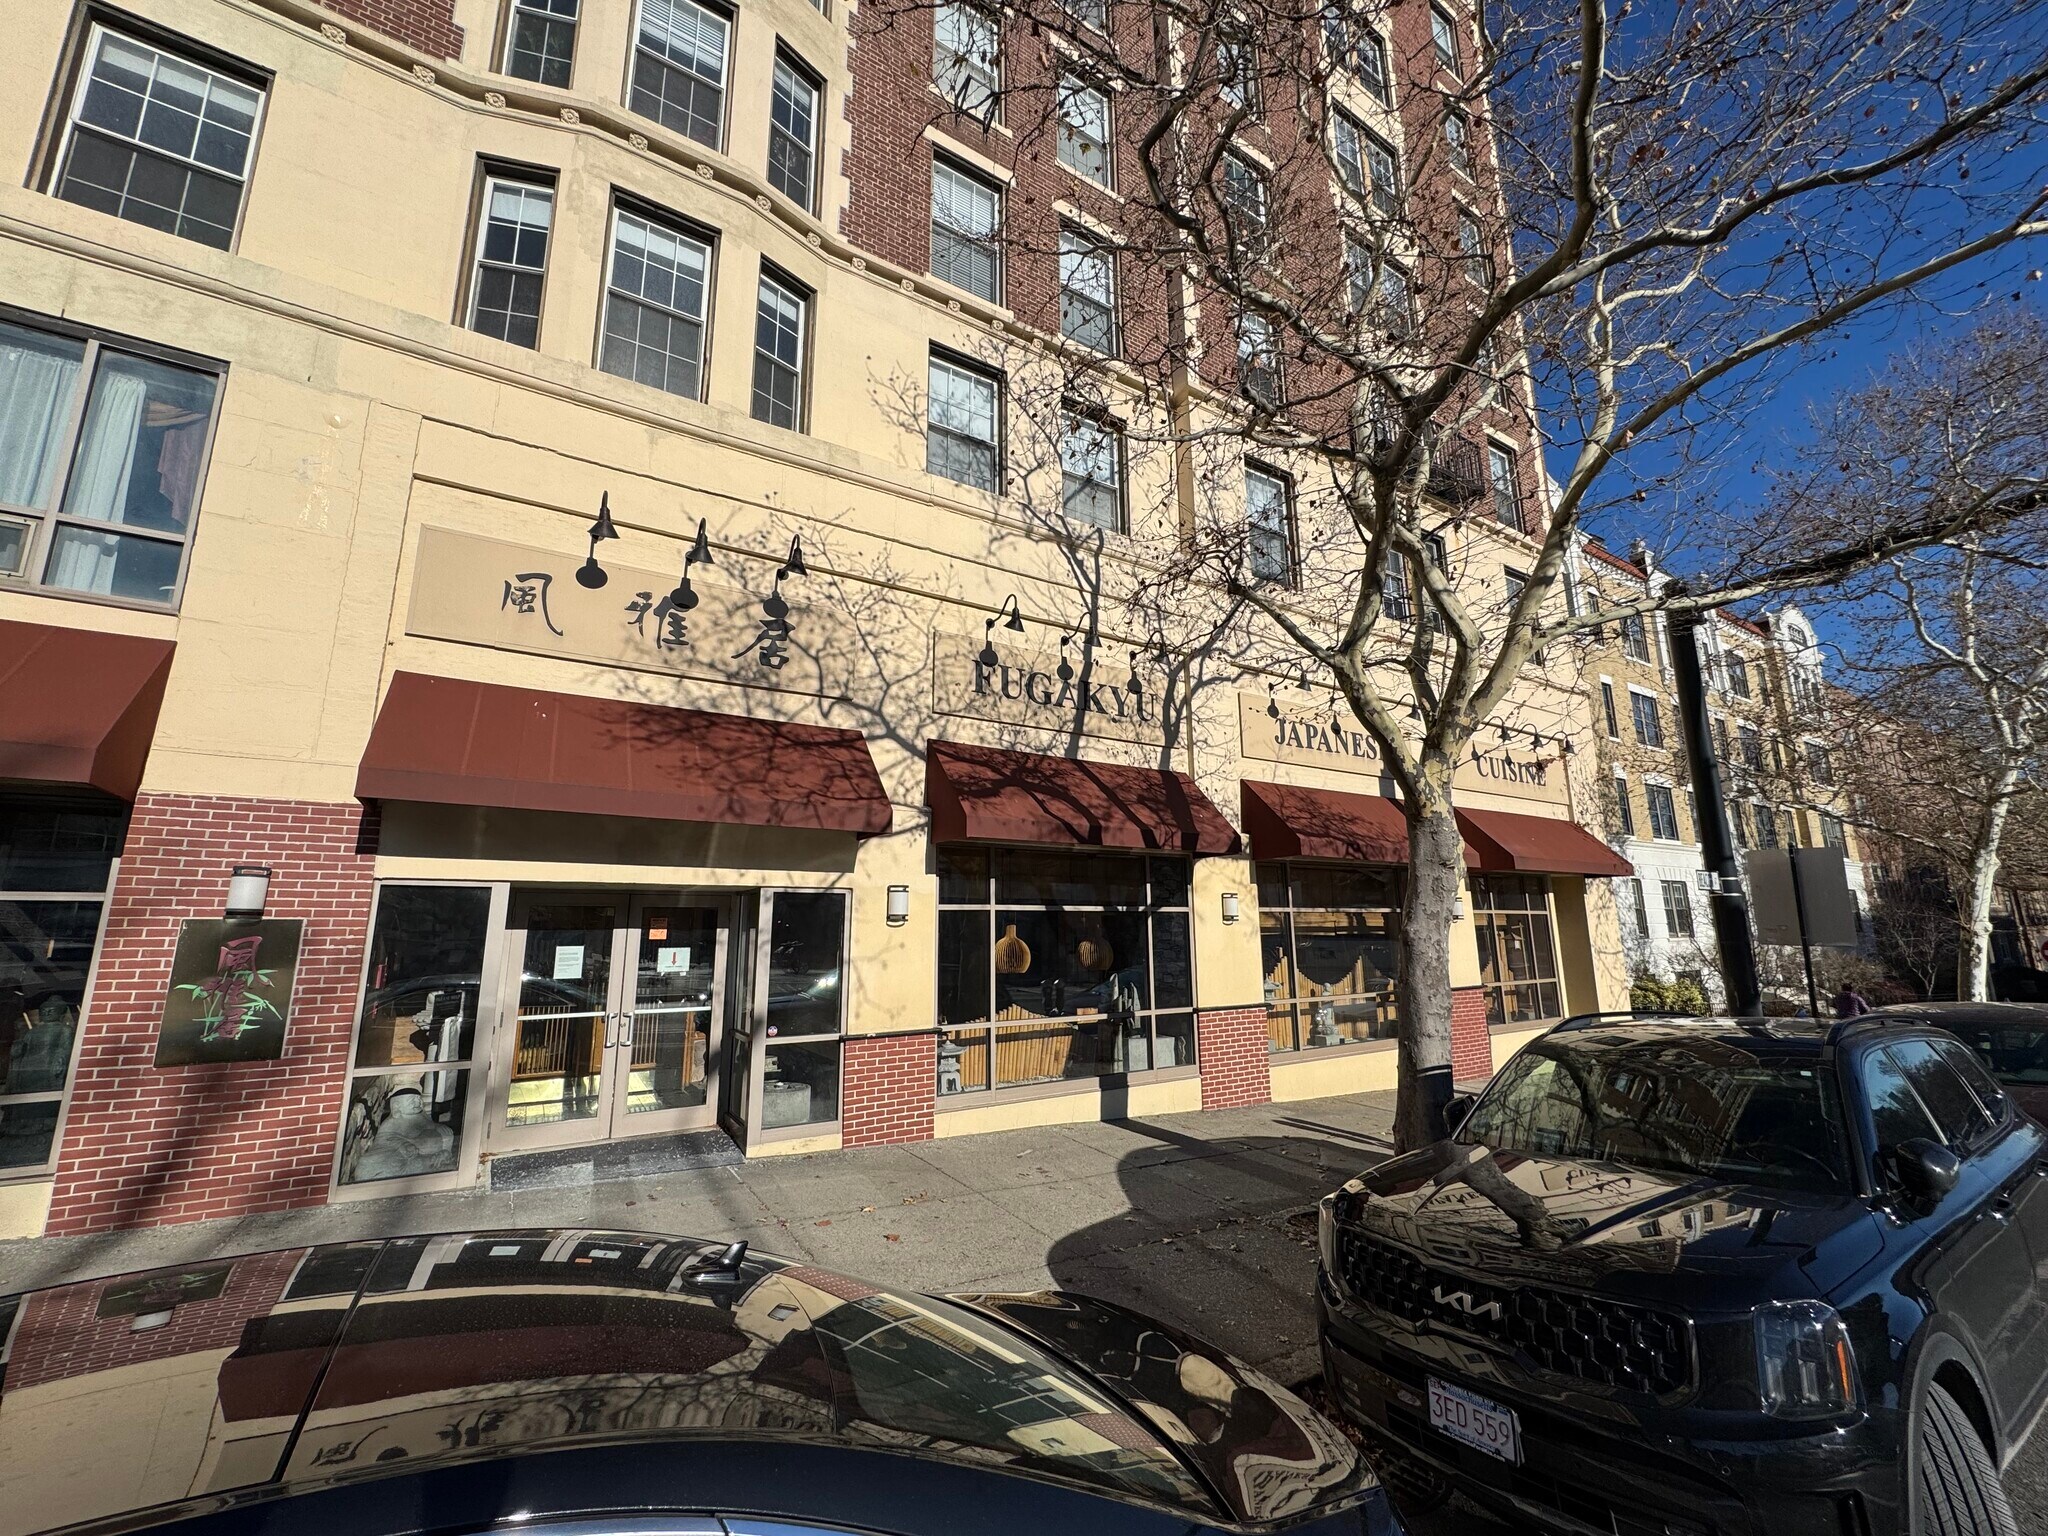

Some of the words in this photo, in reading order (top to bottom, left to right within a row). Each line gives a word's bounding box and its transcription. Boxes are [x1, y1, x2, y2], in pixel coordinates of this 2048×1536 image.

[972, 659, 1157, 722] FUGAKYU
[1274, 717, 1382, 760] JAPANES
[1476, 756, 1547, 787] CUISINE
[1433, 1285, 1500, 1321] KIA
[1431, 1391, 1467, 1428] 3ED
[1472, 1409, 1509, 1446] 559
